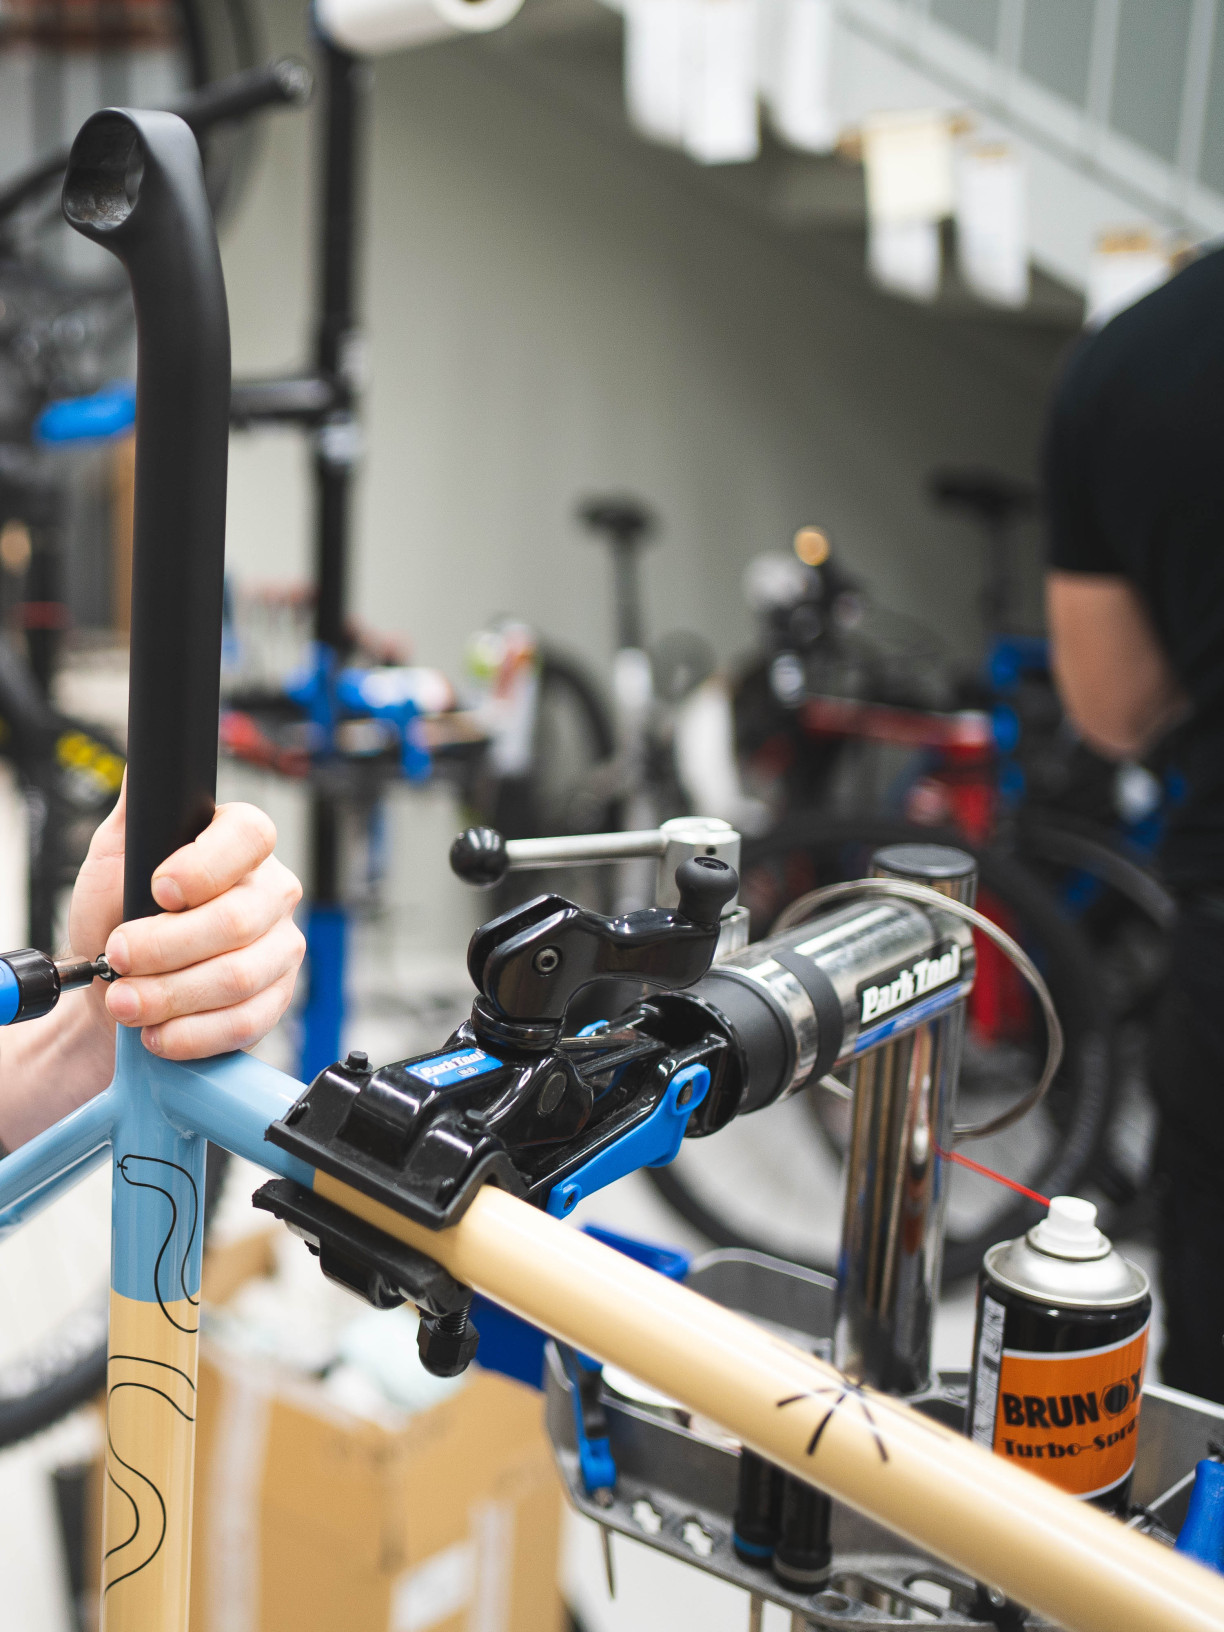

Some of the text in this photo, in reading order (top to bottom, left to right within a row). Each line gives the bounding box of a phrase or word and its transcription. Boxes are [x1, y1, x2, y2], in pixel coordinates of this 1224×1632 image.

[862, 969, 915, 1024] Park
[913, 944, 961, 992] Tool
[1001, 1419, 1137, 1458] Turbo-Spra
